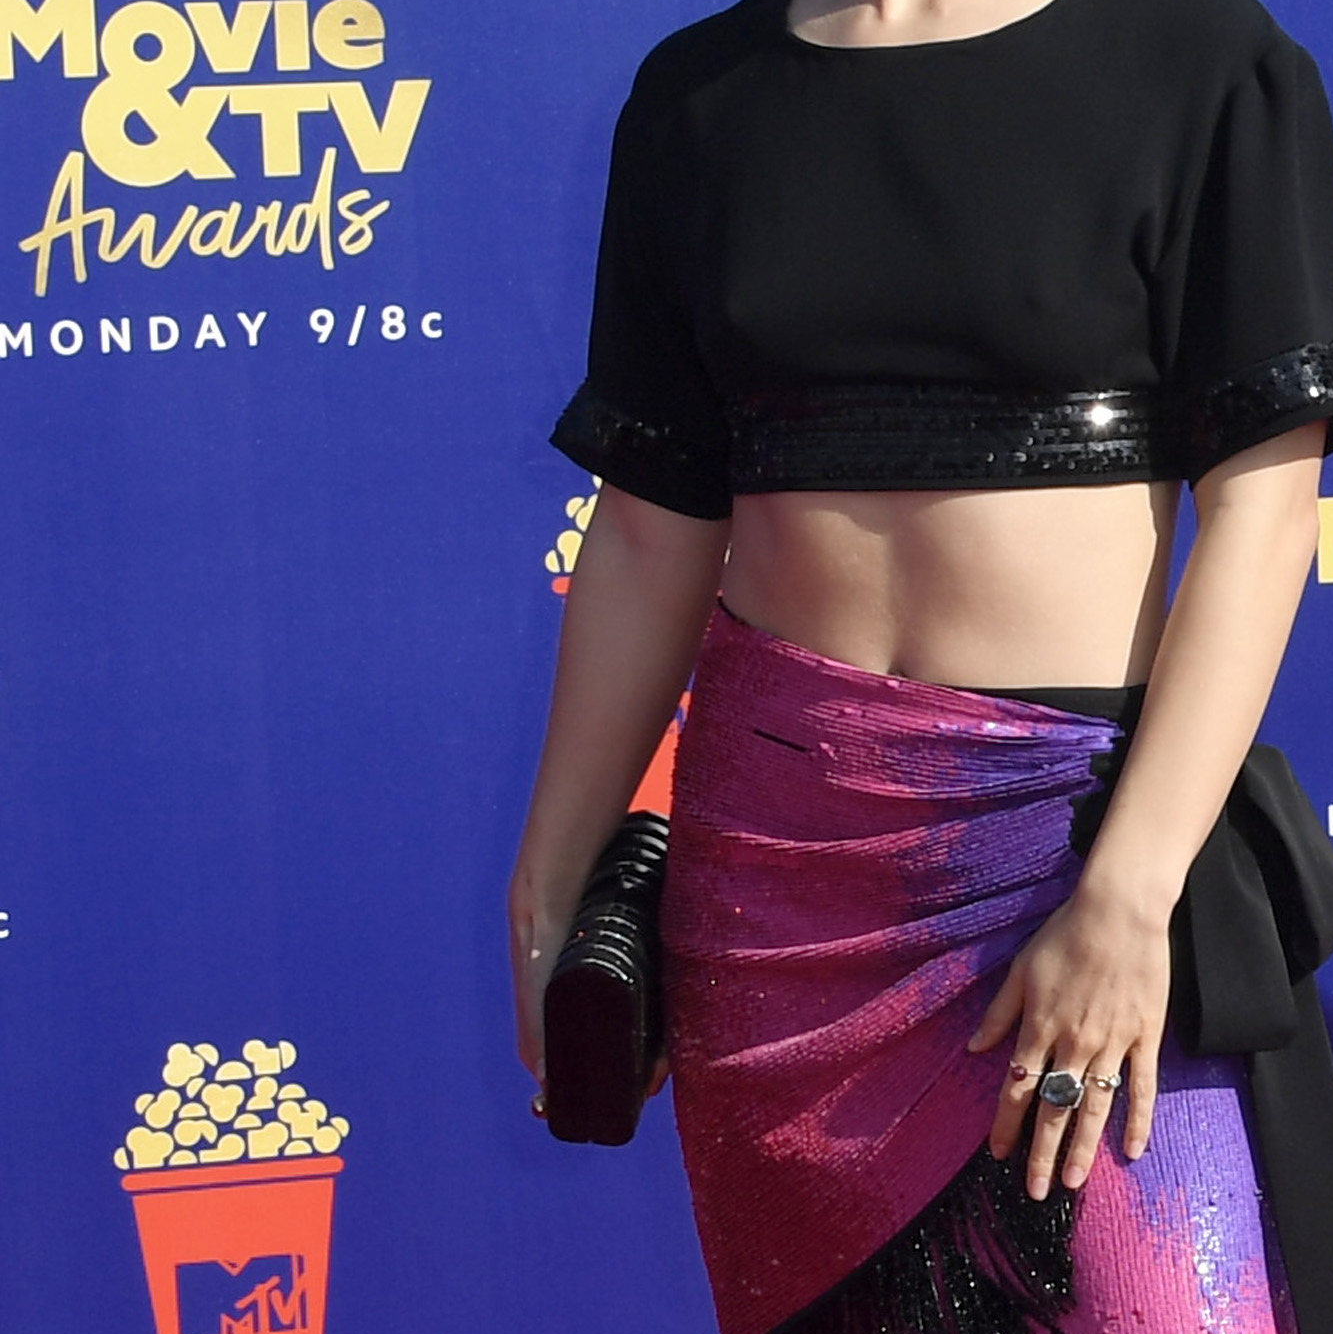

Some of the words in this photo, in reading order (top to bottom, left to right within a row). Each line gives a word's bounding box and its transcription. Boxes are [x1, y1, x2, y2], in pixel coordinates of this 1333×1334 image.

[18, 147, 390, 297] Awards
[0, 310, 268, 358] MONDAY
[308, 304, 443, 347] 9/8c
